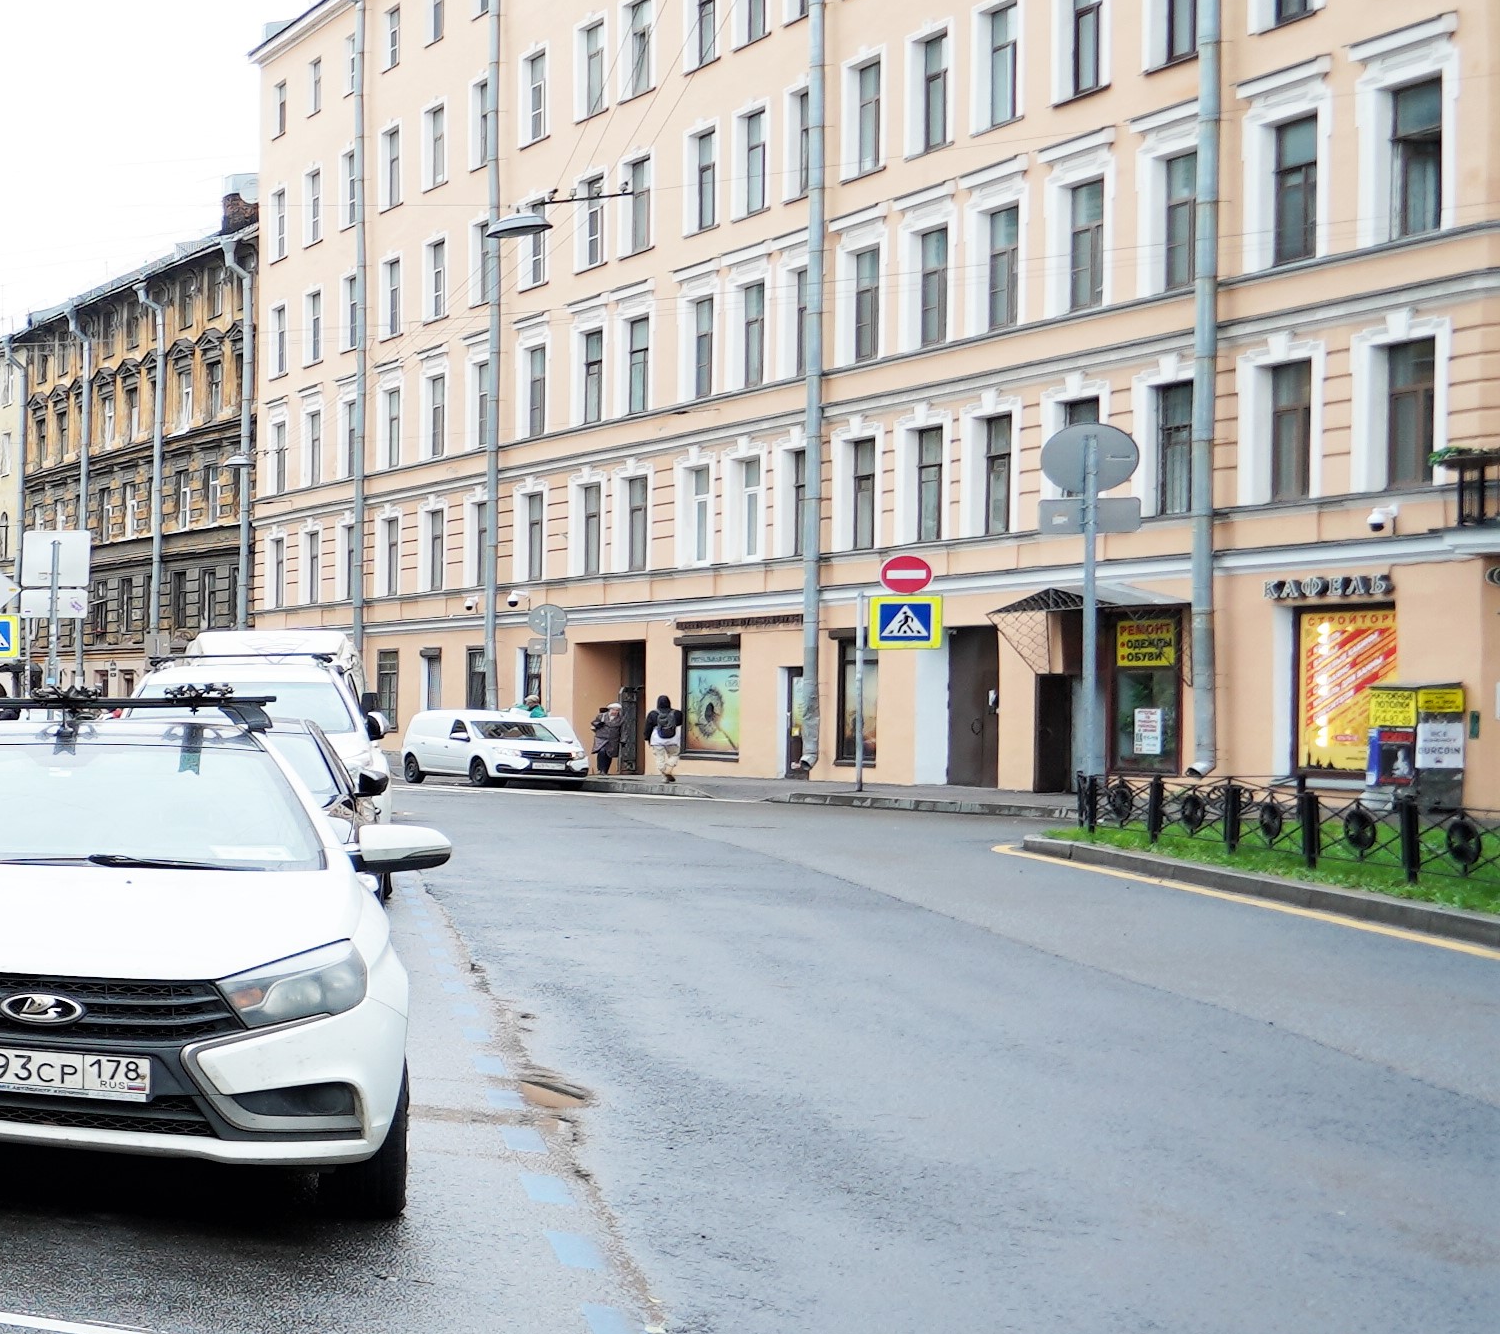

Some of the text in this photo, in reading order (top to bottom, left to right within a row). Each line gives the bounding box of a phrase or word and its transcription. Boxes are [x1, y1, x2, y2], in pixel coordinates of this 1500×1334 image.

[1264, 574, 1388, 599] КАФЕЛЬ
[1119, 623, 1171, 636] РЕМОНТ
[1126, 638, 1172, 650] ОДЕЖДЫ
[1126, 652, 1163, 662] ОБУВИ
[89, 1058, 141, 1082] 178
[100, 1080, 126, 1090] RUS
